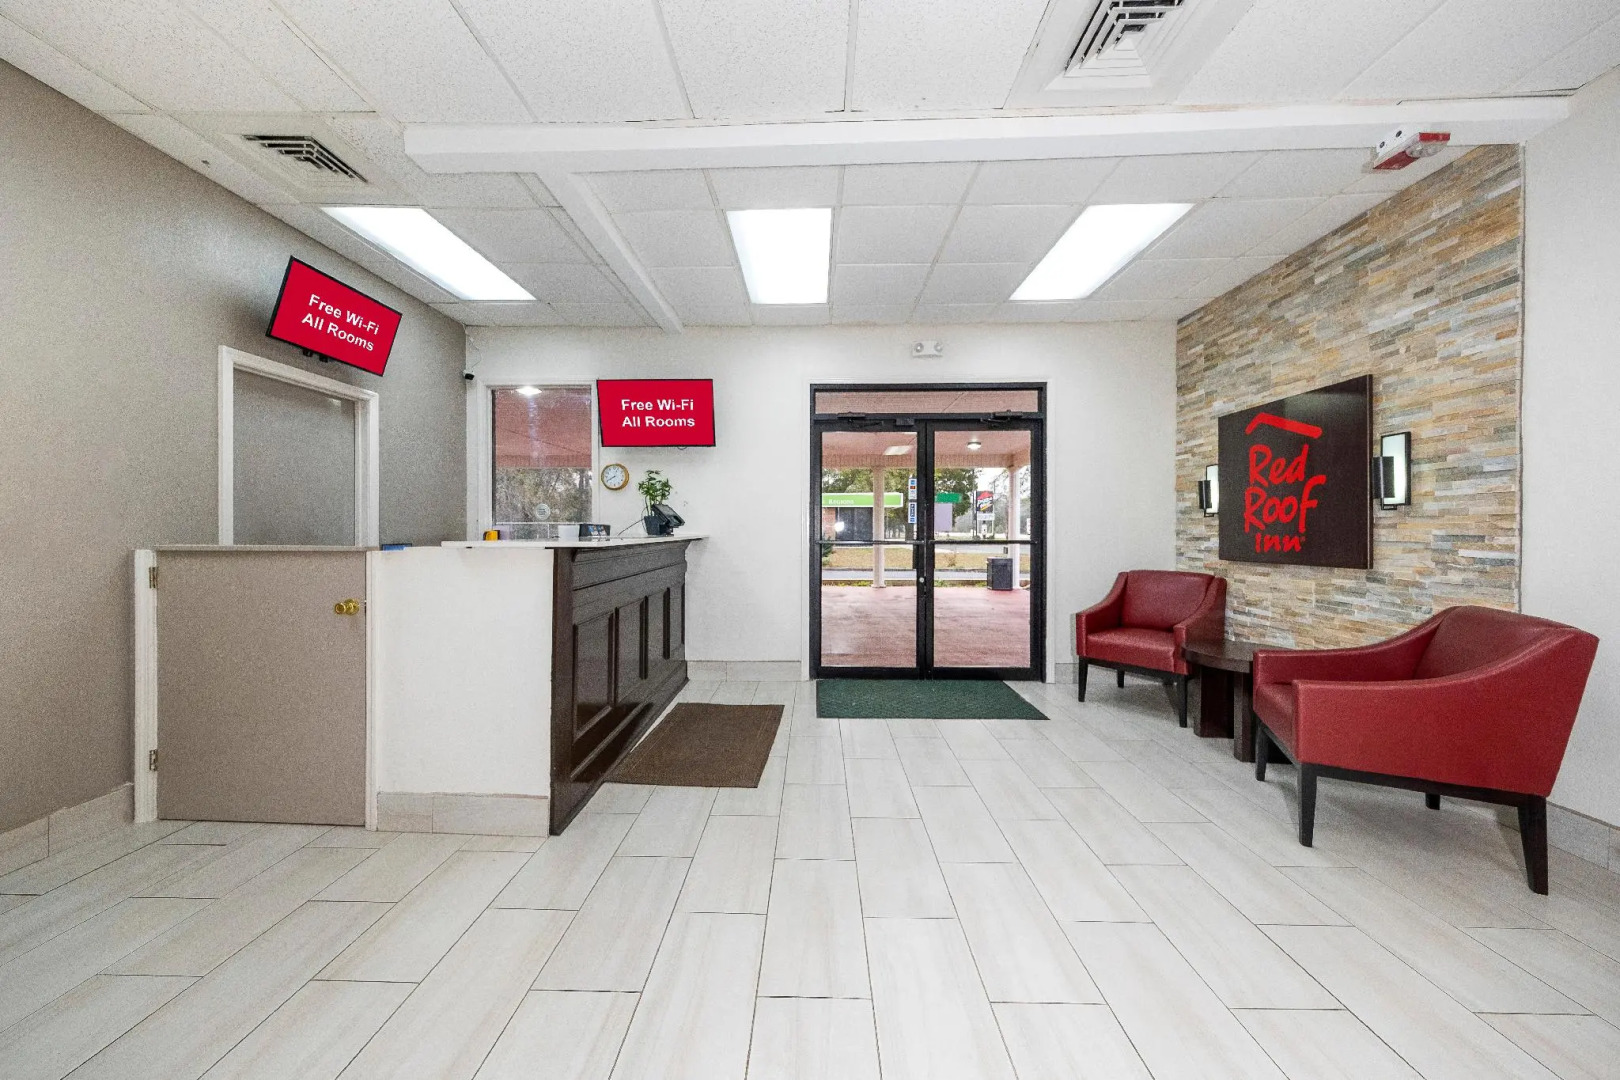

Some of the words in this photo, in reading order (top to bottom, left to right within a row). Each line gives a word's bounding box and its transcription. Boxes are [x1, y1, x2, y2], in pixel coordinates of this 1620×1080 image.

[301, 313, 325, 331] All
[327, 322, 374, 352] Rooms
[308, 293, 342, 319] Free
[345, 310, 380, 335] Wi-Fi
[621, 398, 653, 411] Free
[656, 398, 694, 411] Wi-Fi
[622, 416, 641, 427] All
[645, 416, 696, 427] Rooms
[1248, 443, 1309, 488] Red
[1243, 474, 1327, 533] Roof
